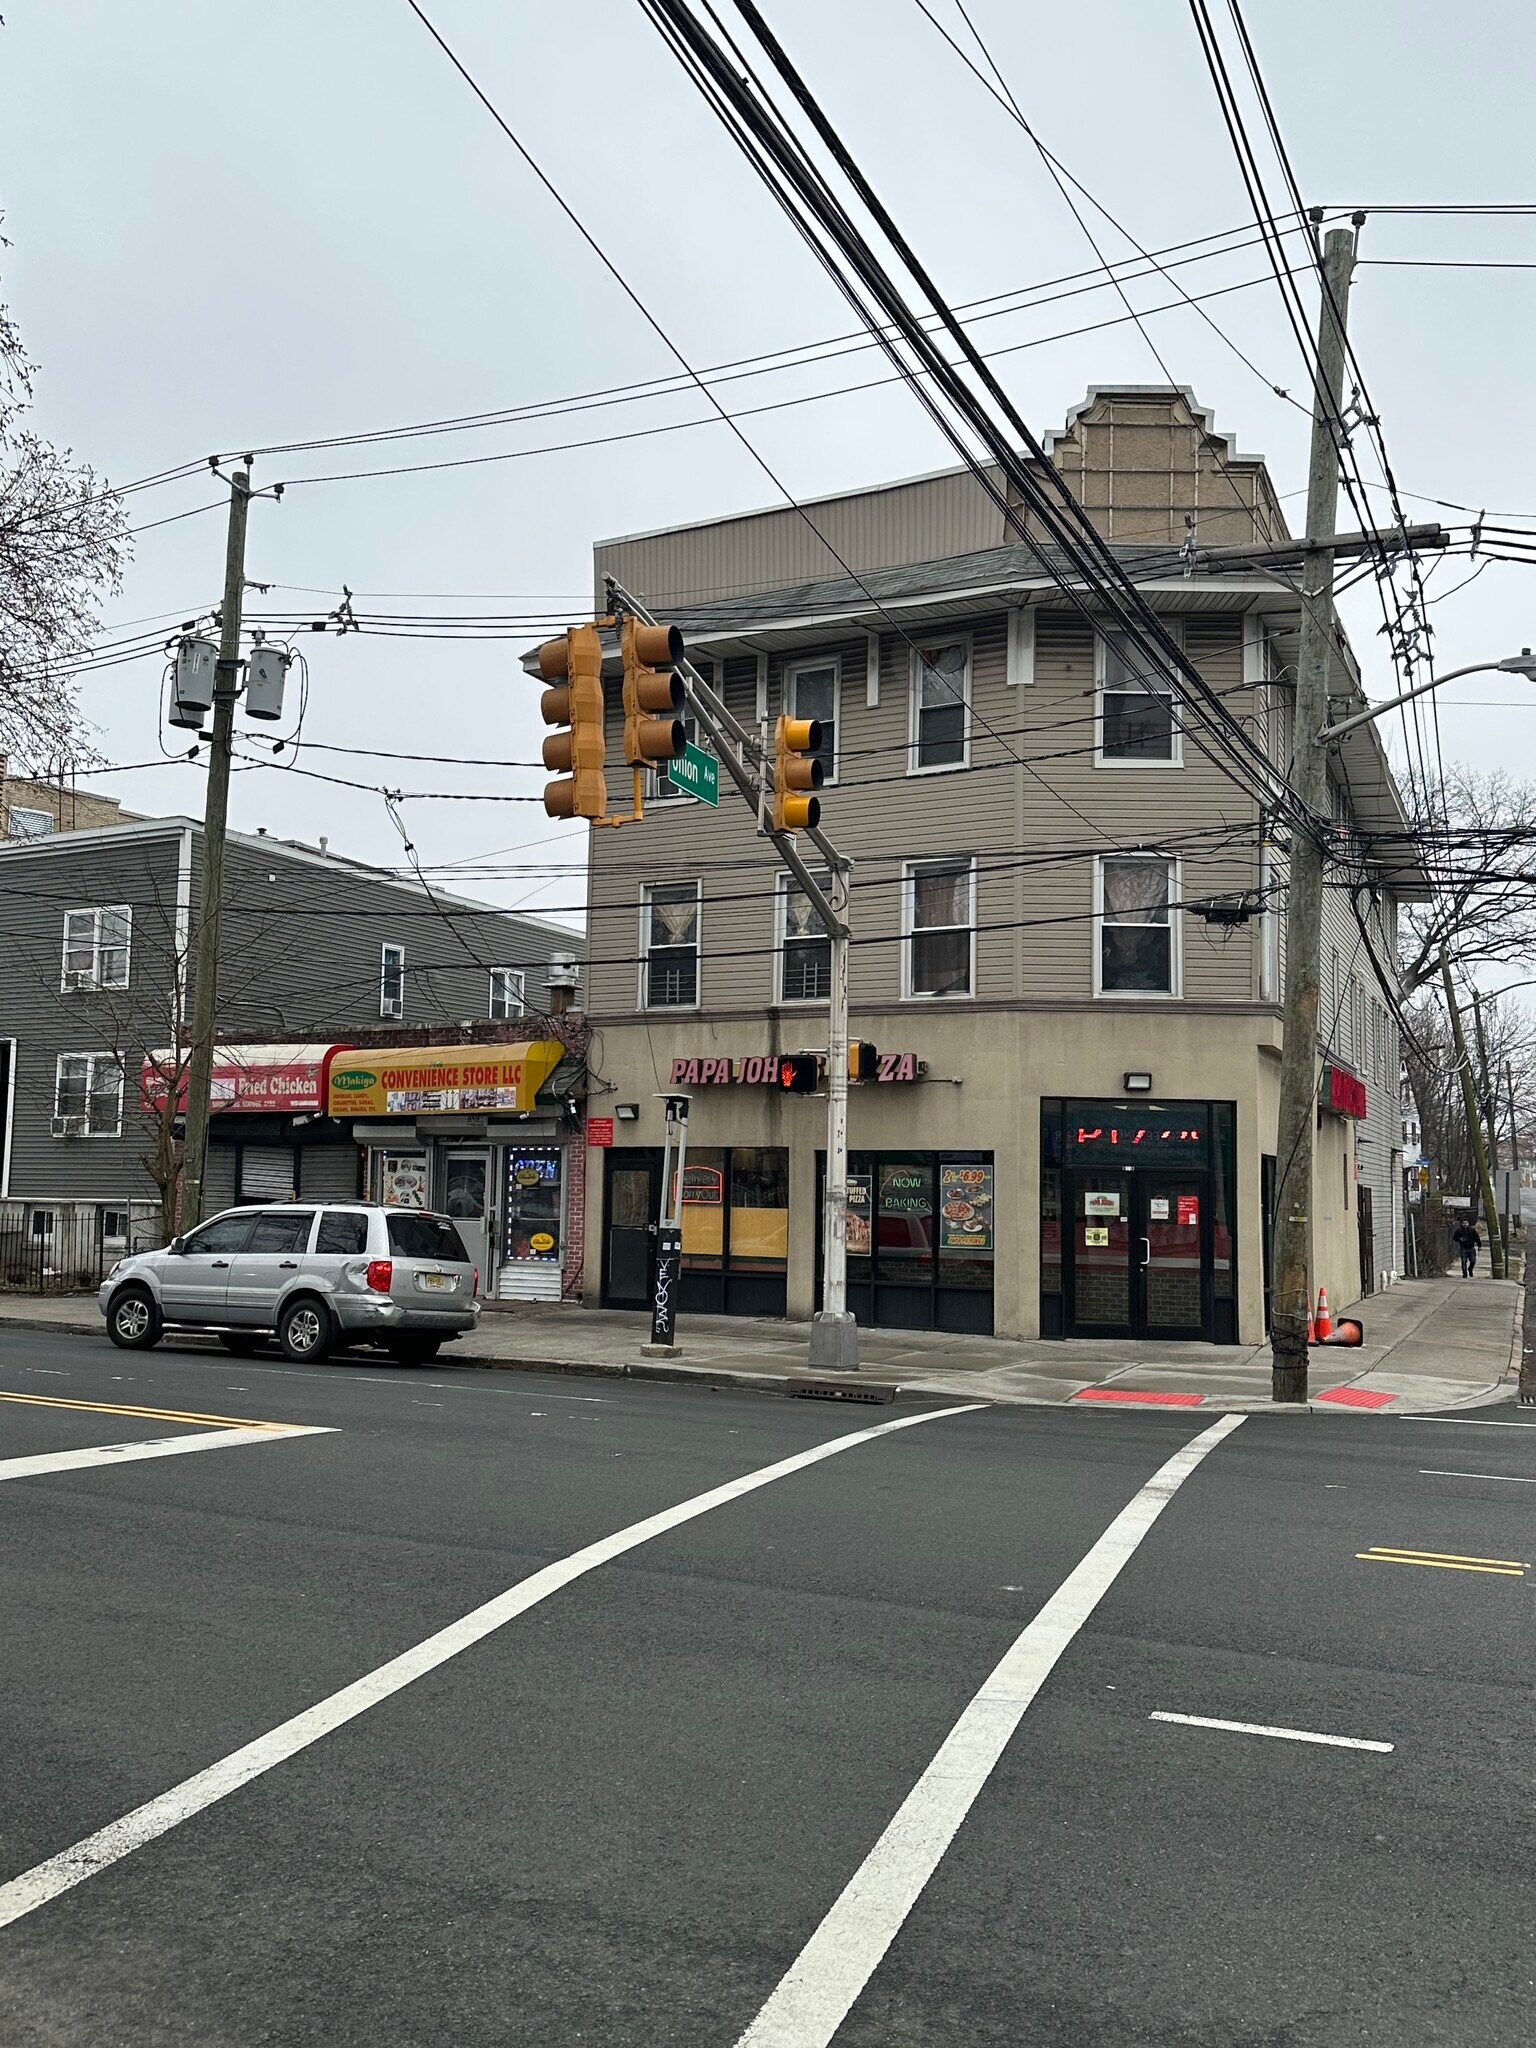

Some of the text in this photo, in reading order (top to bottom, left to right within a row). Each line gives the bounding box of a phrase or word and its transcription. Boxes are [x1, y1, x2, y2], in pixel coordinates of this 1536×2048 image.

[673, 754, 715, 785] Union Ave
[381, 1065, 522, 1089] CONVENIENCE STORE LLC
[670, 1057, 731, 1085] PAPA
[238, 1076, 317, 1095] Fried Chicken
[682, 1173, 718, 1185] elivery
[943, 1170, 952, 1183] 2
[959, 1169, 986, 1183] $6.99
[892, 1177, 921, 1188] NOW
[682, 1189, 719, 1200] arryOut
[846, 1186, 867, 1195] TUFFED
[849, 1195, 865, 1203] PIZZA
[885, 1197, 927, 1208] BAKING
